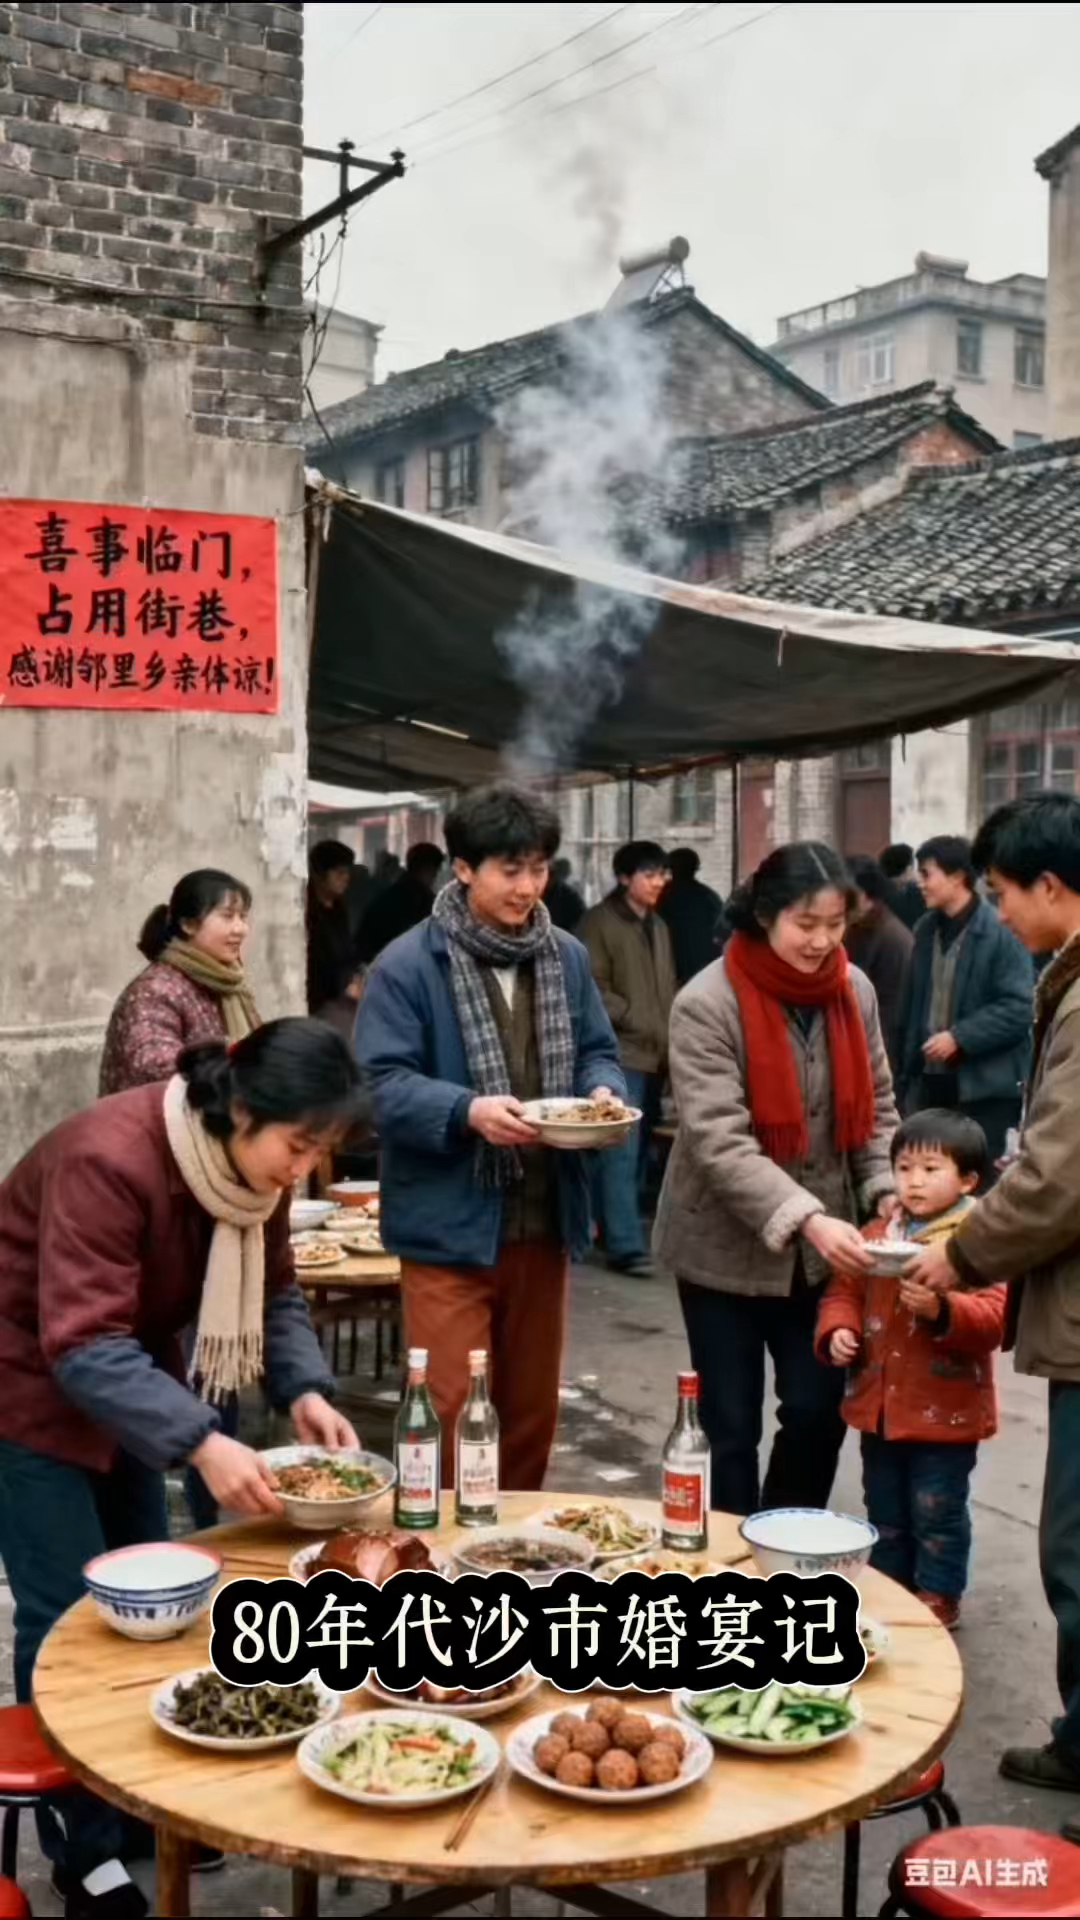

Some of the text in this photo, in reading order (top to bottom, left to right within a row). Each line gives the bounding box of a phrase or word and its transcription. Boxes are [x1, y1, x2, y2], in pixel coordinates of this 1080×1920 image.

[25, 511, 252, 583] 喜事临门，
[37, 582, 248, 643] 占用街巷，
[7, 642, 275, 695] 感谢邻里乡亲体谅！
